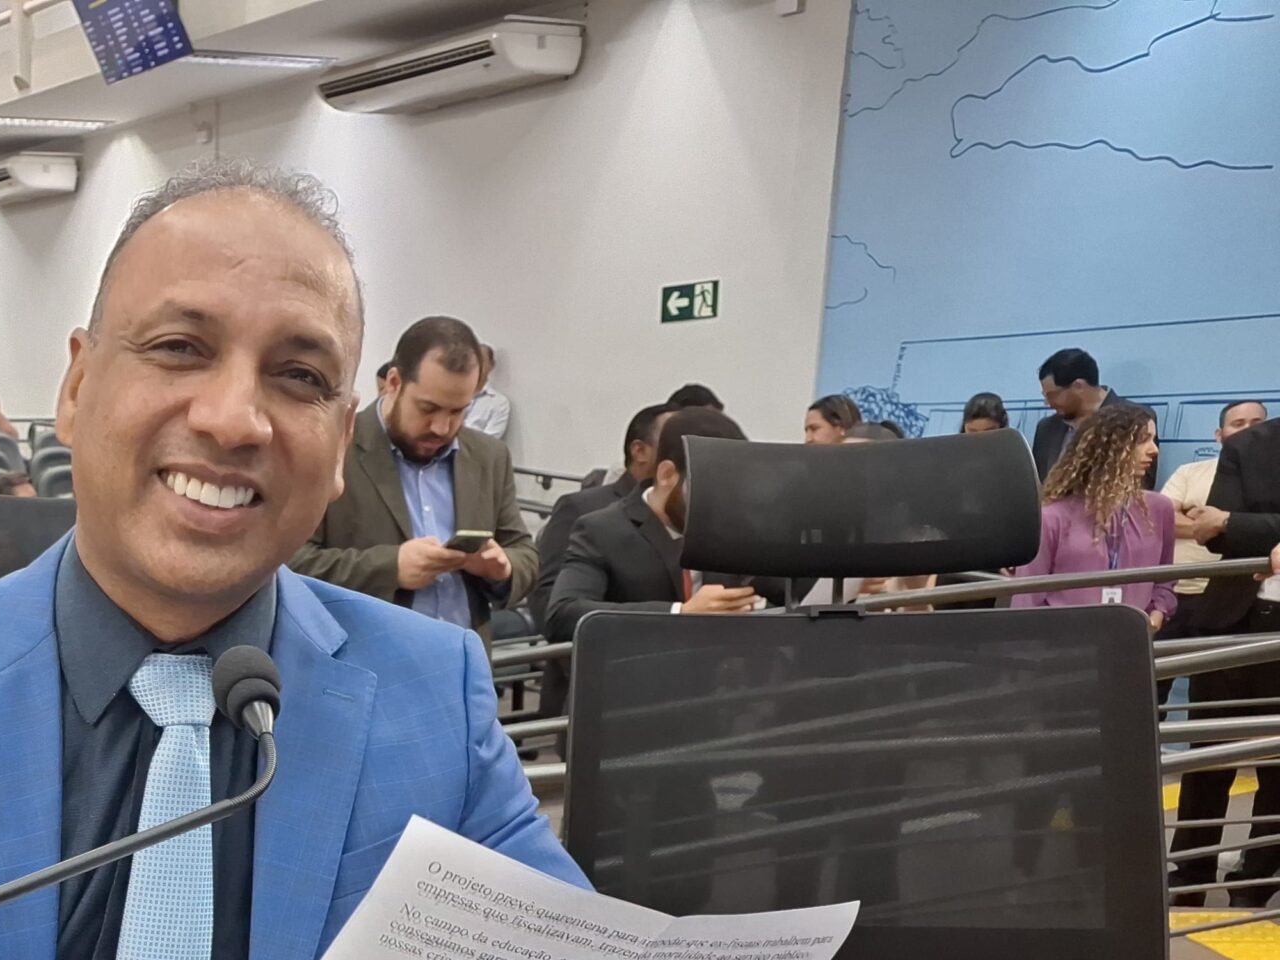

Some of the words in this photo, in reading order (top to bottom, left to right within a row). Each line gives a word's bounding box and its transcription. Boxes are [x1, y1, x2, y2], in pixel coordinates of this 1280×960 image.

[400, 902, 421, 918] No
[424, 913, 469, 937] campo
[472, 927, 488, 943] da
[417, 882, 479, 910] empresas
[482, 905, 508, 920] que
[512, 911, 593, 948] fiscalizavam,
[599, 939, 651, 959] trazendo
[428, 863, 441, 876] O
[442, 872, 491, 896] projeto
[494, 891, 534, 912] prevê
[536, 906, 608, 936] quarentena
[611, 931, 638, 945] para
[379, 933, 423, 955] nossas
[390, 921, 475, 956] conseguimos
